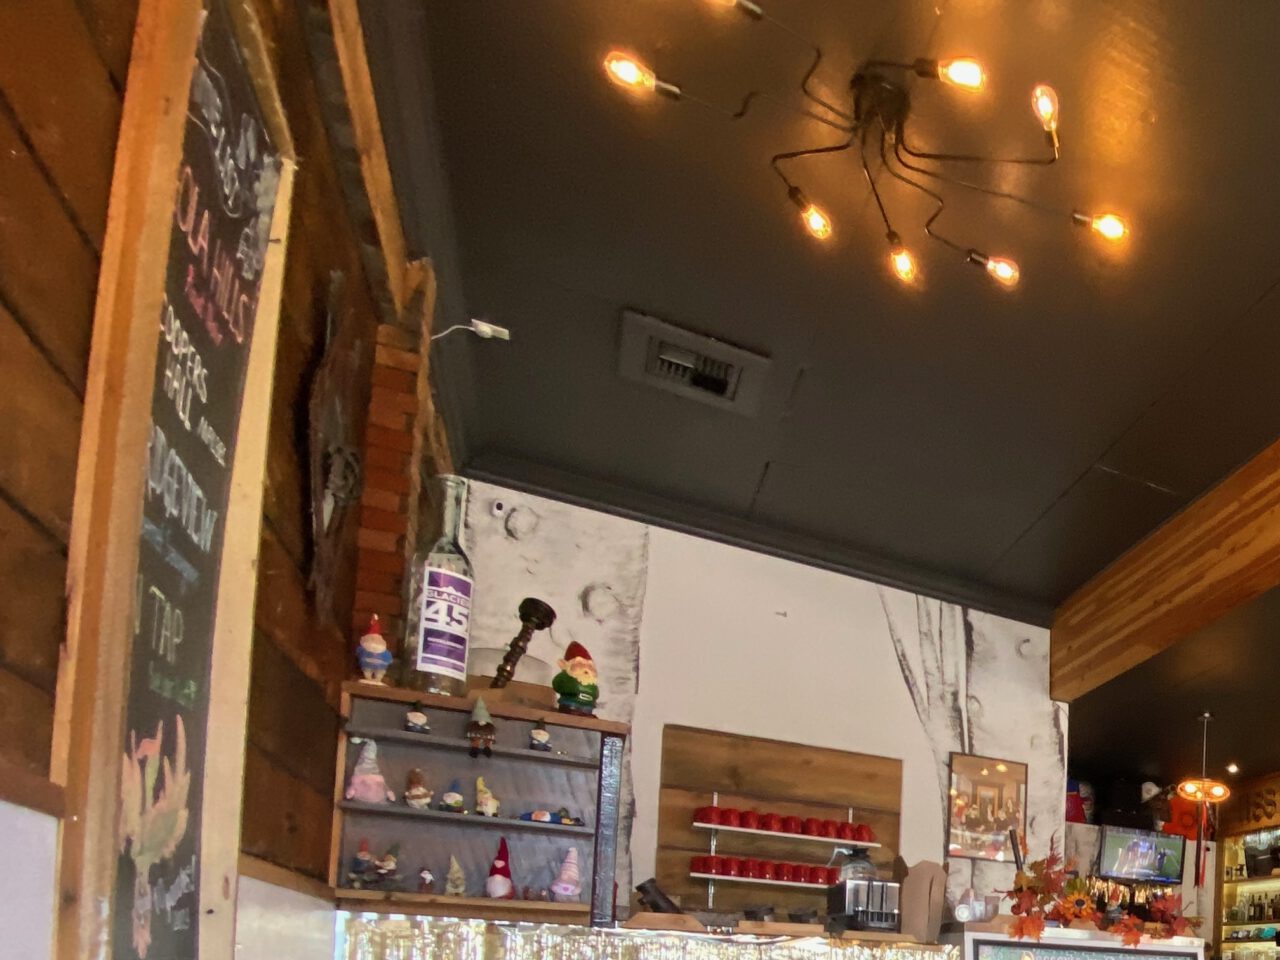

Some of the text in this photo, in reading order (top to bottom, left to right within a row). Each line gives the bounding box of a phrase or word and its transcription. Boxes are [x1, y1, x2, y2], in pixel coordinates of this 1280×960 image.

[173, 166, 209, 278] OLA
[163, 350, 192, 432] HALL
[145, 420, 218, 553] DGEVIEW
[149, 584, 185, 665] TAP
[425, 600, 469, 633] 45
